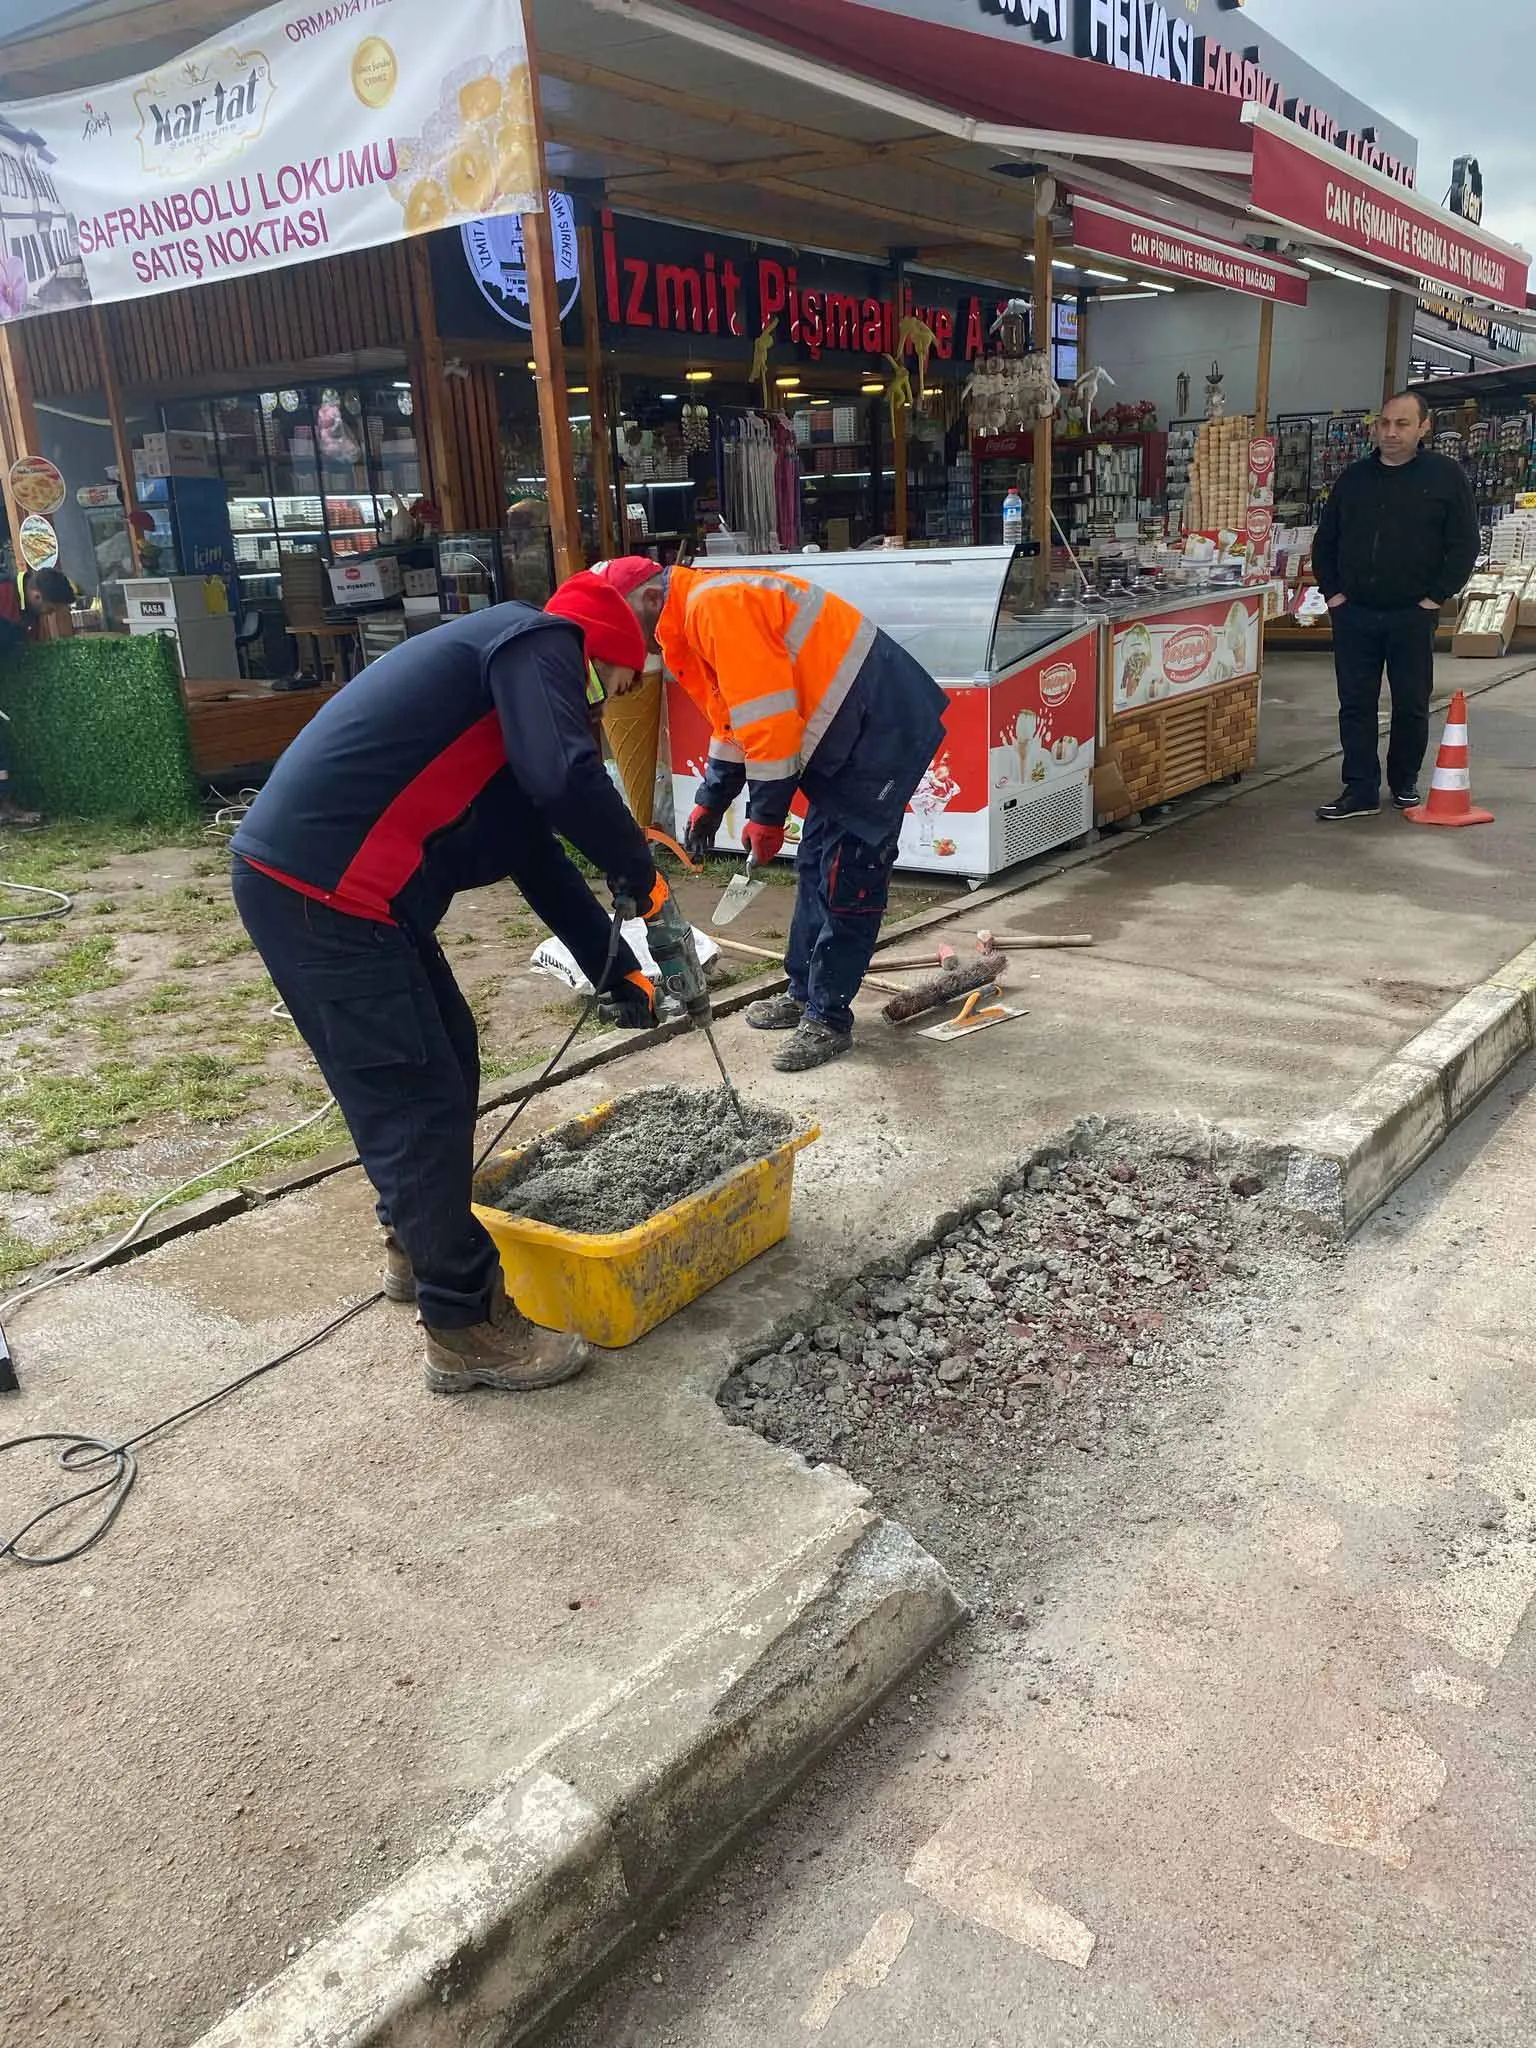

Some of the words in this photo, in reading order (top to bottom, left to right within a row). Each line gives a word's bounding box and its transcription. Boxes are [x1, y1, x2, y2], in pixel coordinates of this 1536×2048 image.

[1090, 0, 1193, 86] HELVASI
[79, 177, 250, 254] SAFRANBOLU
[257, 137, 397, 210] LOKUMU
[1325, 182, 1350, 228] CAN
[1353, 191, 1410, 253] PİŞMANİYE
[1411, 224, 1448, 268] FABRİKA
[1472, 251, 1506, 291] MAĞAZASI
[132, 238, 203, 283] SATIŞ
[206, 207, 328, 268] NOKTASI
[602, 207, 746, 337] İzmit
[1131, 233, 1149, 256] CAN
[1150, 235, 1194, 268] PİŞMANİYE
[1194, 252, 1225, 279] FABRİKA
[1225, 262, 1245, 287] SATIŞ
[1244, 267, 1276, 292] MAĞAZASI
[142, 603, 164, 615] KASA
